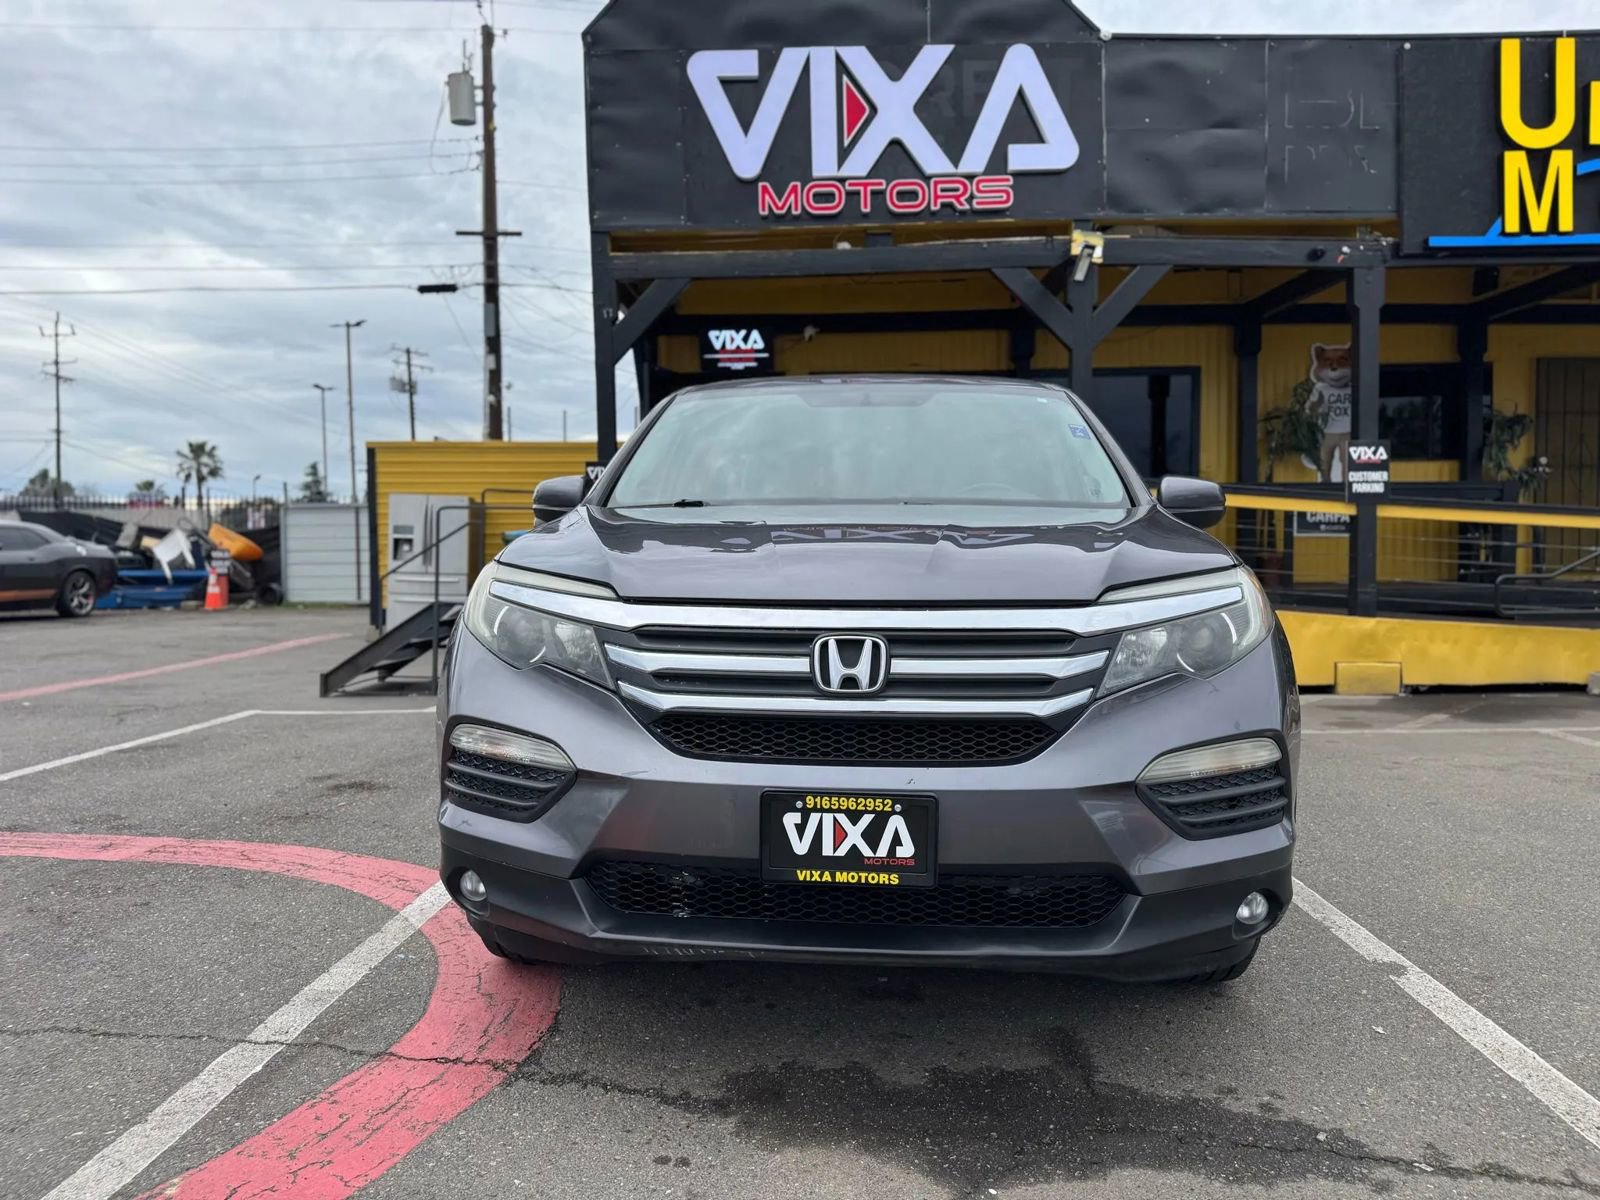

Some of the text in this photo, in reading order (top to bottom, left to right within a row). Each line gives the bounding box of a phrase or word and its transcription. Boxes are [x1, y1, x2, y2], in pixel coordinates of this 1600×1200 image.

[1501, 37, 1600, 149] U
[686, 43, 1080, 182] VIXA
[757, 175, 1014, 216] MOTORS
[708, 329, 765, 350] VIXA
[1328, 393, 1351, 404] CAR
[1328, 406, 1350, 417] FOX
[1349, 446, 1388, 460] VIXA
[1349, 471, 1388, 482] CUSTOMER
[1352, 482, 1384, 493] PARKING
[806, 796, 892, 811] 9165962952
[783, 812, 915, 857] VIXA
[797, 870, 899, 885] VIXA MOTORS
